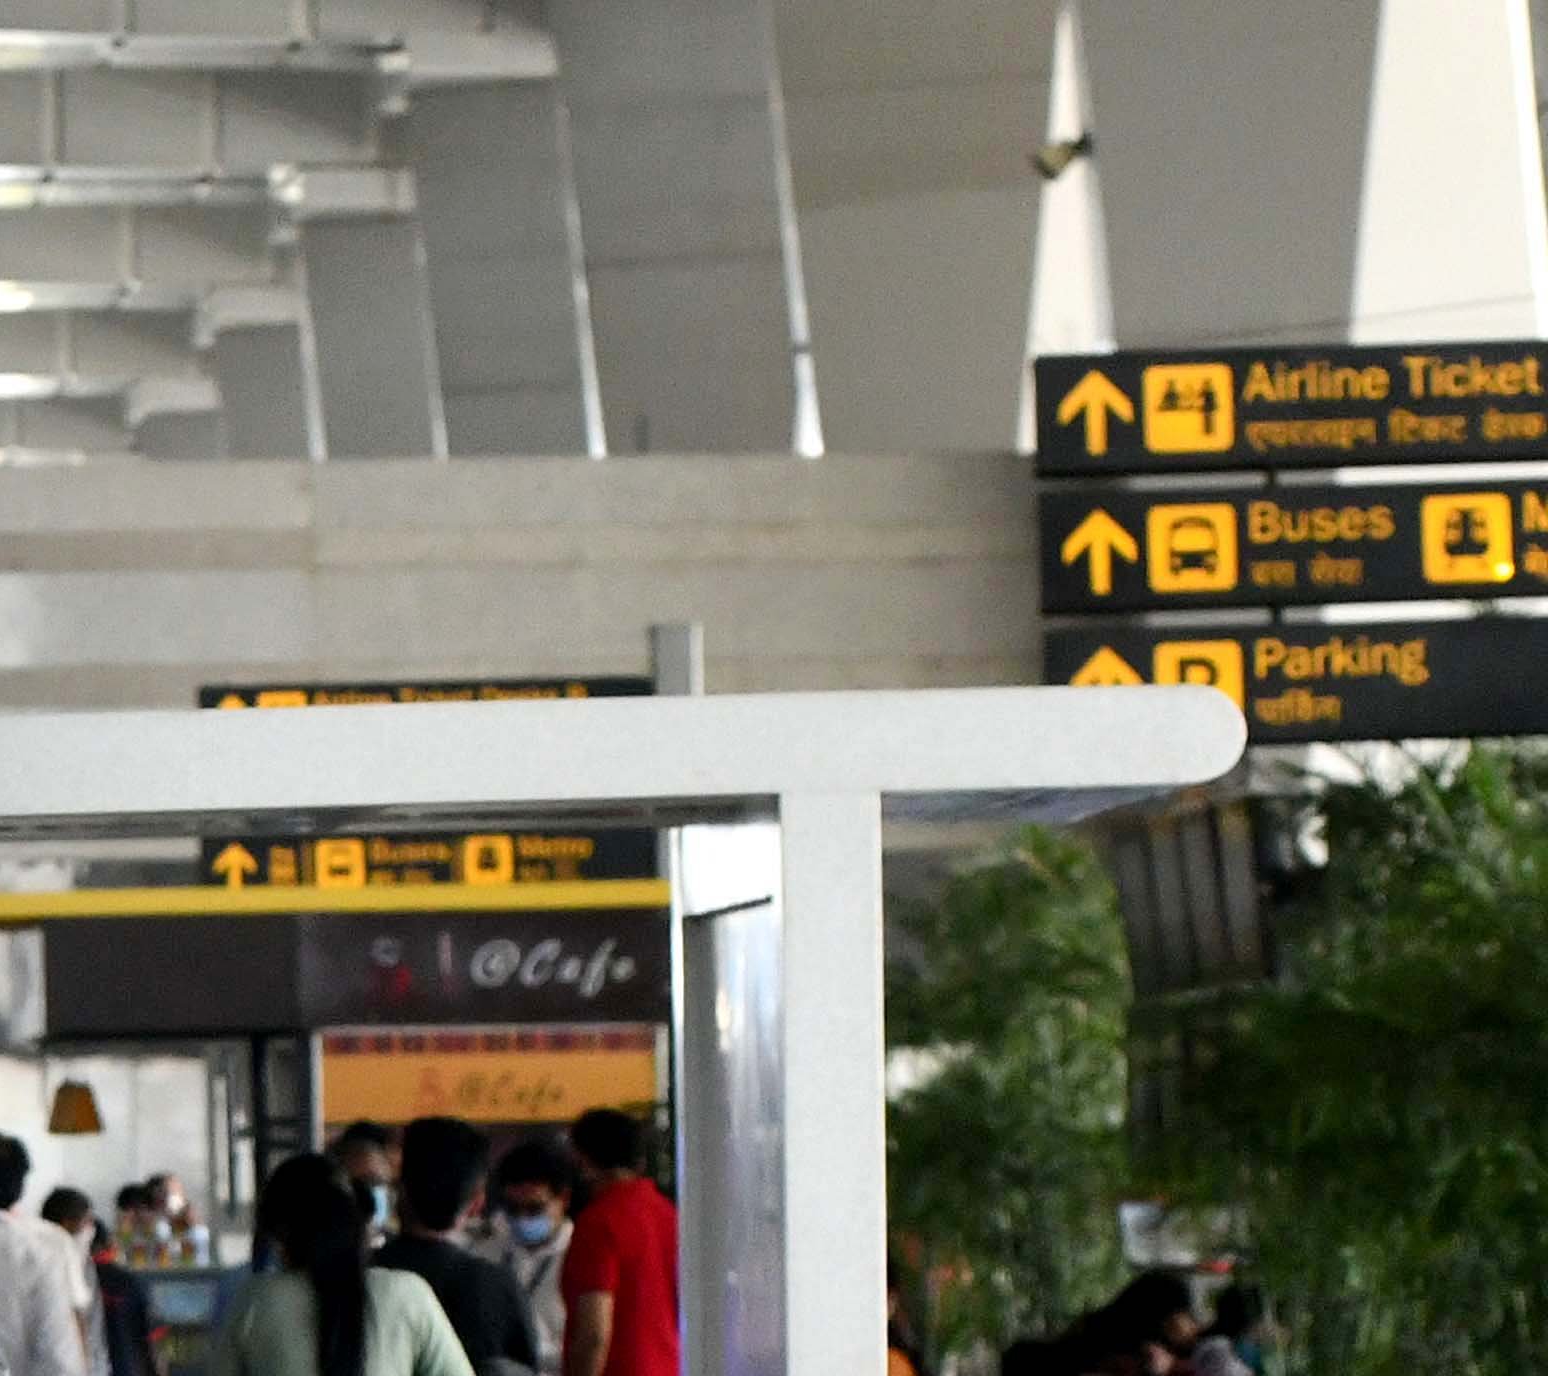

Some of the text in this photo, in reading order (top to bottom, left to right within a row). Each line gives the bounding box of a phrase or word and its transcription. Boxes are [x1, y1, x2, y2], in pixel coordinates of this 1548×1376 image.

[1243, 354, 1544, 402] Airline Ticket
[1247, 500, 1397, 544] Buses
[1254, 635, 1431, 686] Parking
